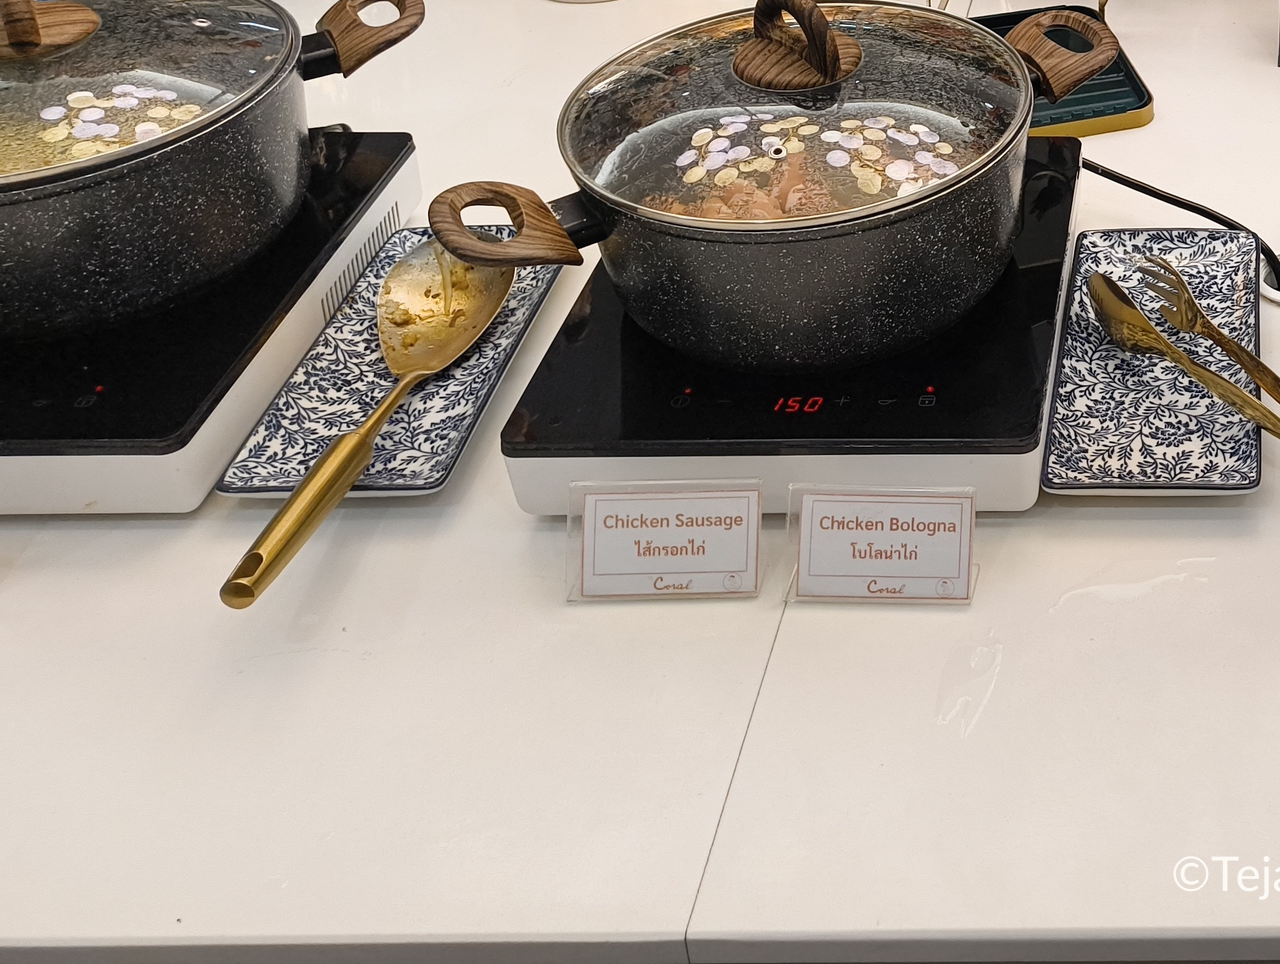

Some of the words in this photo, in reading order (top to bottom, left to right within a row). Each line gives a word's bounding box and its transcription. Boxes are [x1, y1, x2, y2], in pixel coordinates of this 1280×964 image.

[774, 397, 824, 412] 150
[603, 514, 670, 530] Chicken
[675, 513, 744, 531] Sausage
[819, 516, 884, 531] Chicken
[889, 517, 957, 536] Bologna
[634, 539, 706, 557] ไส้กรอกไก่
[851, 542, 918, 560] โบโลน่าไก่
[653, 576, 693, 590] Coral
[867, 579, 906, 594] Coral
